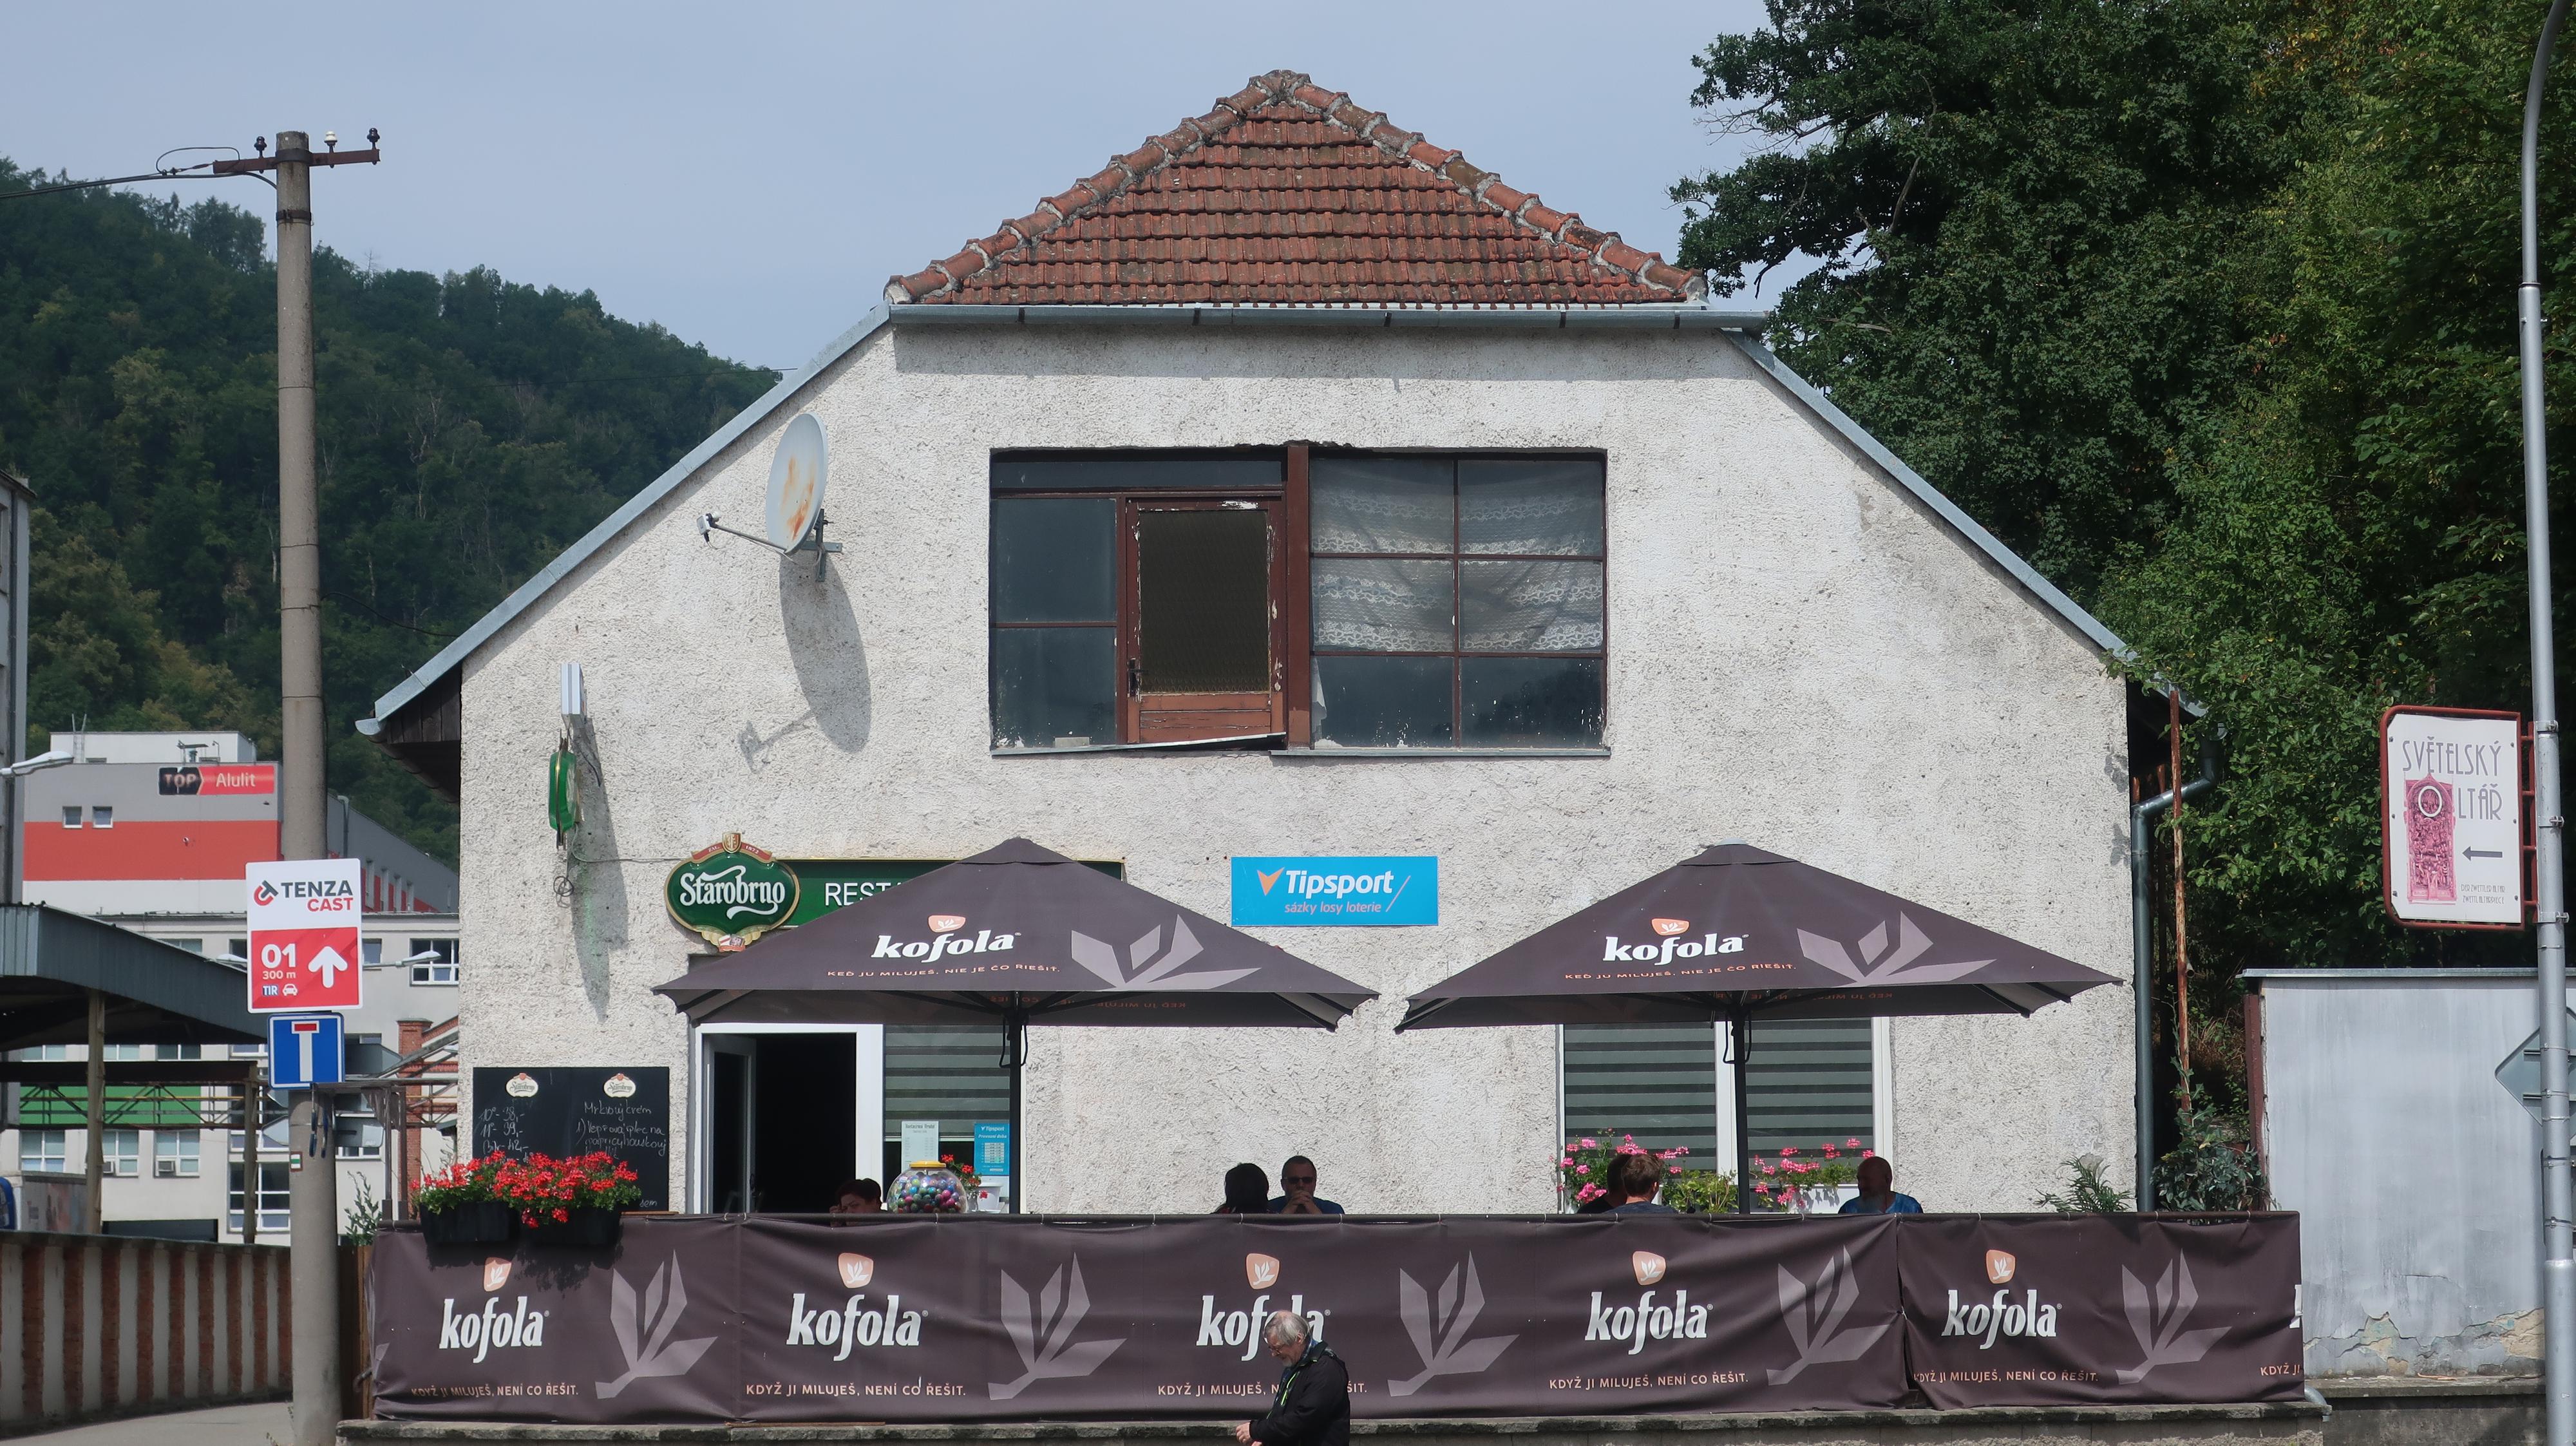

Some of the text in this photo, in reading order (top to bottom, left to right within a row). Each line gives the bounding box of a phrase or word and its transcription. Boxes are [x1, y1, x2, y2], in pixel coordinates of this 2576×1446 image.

[2402, 736, 2501, 776] SVĚTELSKÝ
[164, 773, 256, 788] TOP Alulit
[745, 845, 759, 854] 1872
[281, 880, 354, 899] TENZA
[679, 865, 786, 920] Starobrno
[1286, 870, 1394, 899] Tipsport
[307, 897, 354, 912] CAST
[1285, 901, 1381, 915] sázky losy loterie
[261, 943, 296, 969] 01
[262, 971, 283, 980] 300
[263, 985, 278, 996] TIR
[650, 1127, 665, 1136] na
[1939, 1371, 1946, 1384] JI
[1950, 1369, 2002, 1383] MILUJEŠ,
[2006, 1368, 2035, 1381] NENÍ
[2040, 1371, 2056, 1381] CO
[2061, 1369, 2099, 1382] ŘEŠIT.
[2260, 1362, 2290, 1376] KDYŽ
[746, 1381, 966, 1397] KDYŽ JI MILUJEŠ, NENÍ CO ŘEŠIT.
[1158, 1382, 1191, 1396] KDYŽ
[1196, 1384, 1205, 1397] JI
[1211, 1381, 1266, 1396] MILUJEŠ,
[1549, 1371, 1748, 1391] KDYŽ JI MILUJEŠ, NENÍ CO ŘEŠIT.
[411, 1382, 579, 1398] KDYŽ JI MILUJEŠ, NENÍ CO ŘEŠIT.
